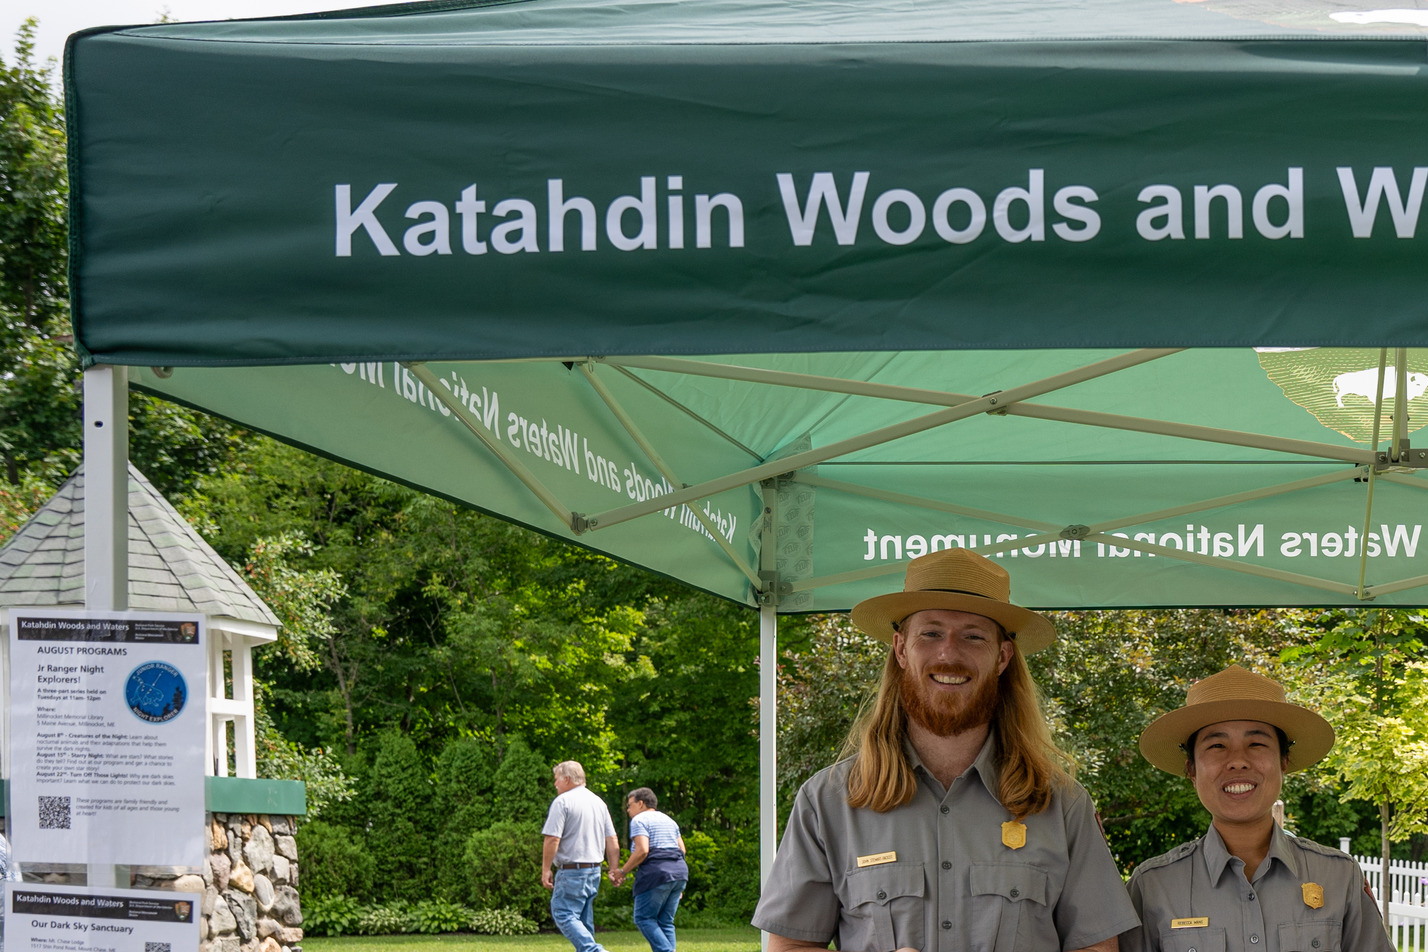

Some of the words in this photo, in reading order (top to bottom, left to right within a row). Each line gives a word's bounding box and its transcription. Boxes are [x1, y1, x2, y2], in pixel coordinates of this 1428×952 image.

[334, 174, 744, 258] Katahdin
[776, 169, 1102, 247] Woods
[1134, 167, 1305, 240] and
[21, 621, 56, 629] Katahdin
[87, 622, 100, 630] and
[103, 623, 129, 631] Waters
[77, 648, 127, 656] PROGRAMS
[48, 665, 78, 674] Ranger
[80, 665, 104, 674] Night
[38, 676, 80, 684] Explorers!
[16, 894, 51, 903] Katahdin
[53, 896, 79, 905] Woods
[81, 898, 95, 906] and
[97, 899, 124, 908] Waters
[31, 920, 48, 929] Our
[50, 921, 70, 930] Dark
[73, 922, 88, 932] Sky
[91, 924, 133, 934] Sanctuary
